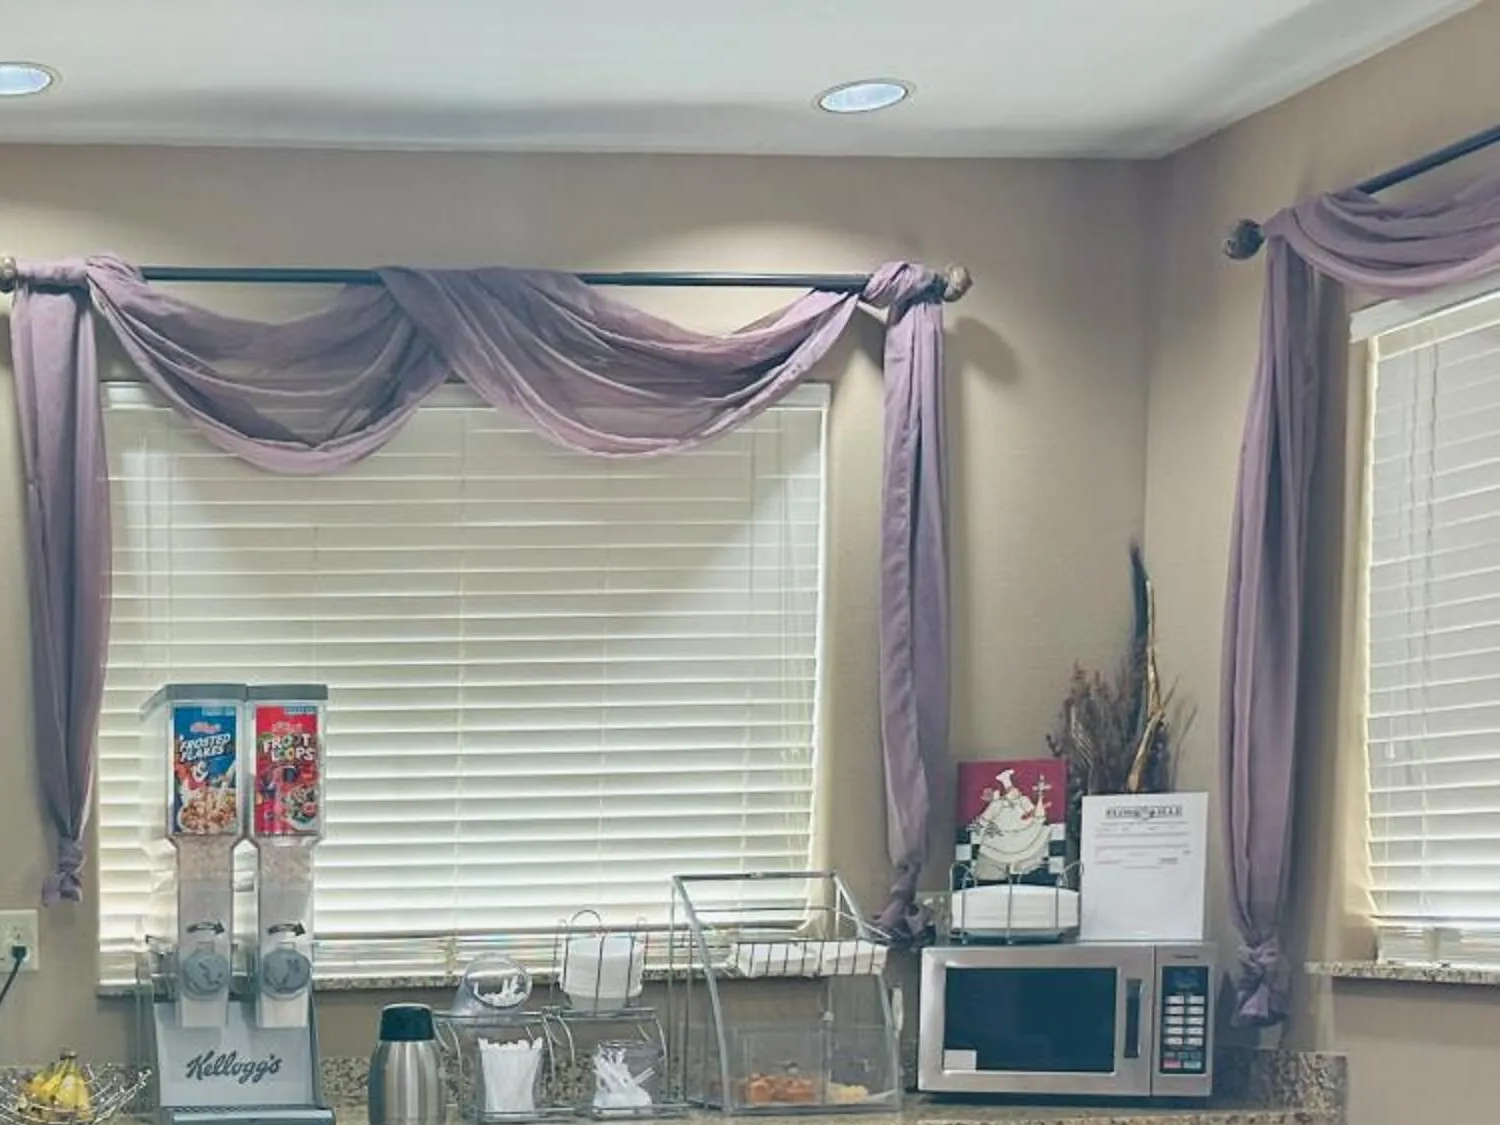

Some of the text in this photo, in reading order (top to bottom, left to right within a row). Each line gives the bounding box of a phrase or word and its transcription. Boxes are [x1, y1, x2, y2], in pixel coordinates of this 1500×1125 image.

[180, 733, 230, 753] FROSTED
[180, 745, 224, 763] FLAKES
[186, 1050, 283, 1084] Kellogg's
